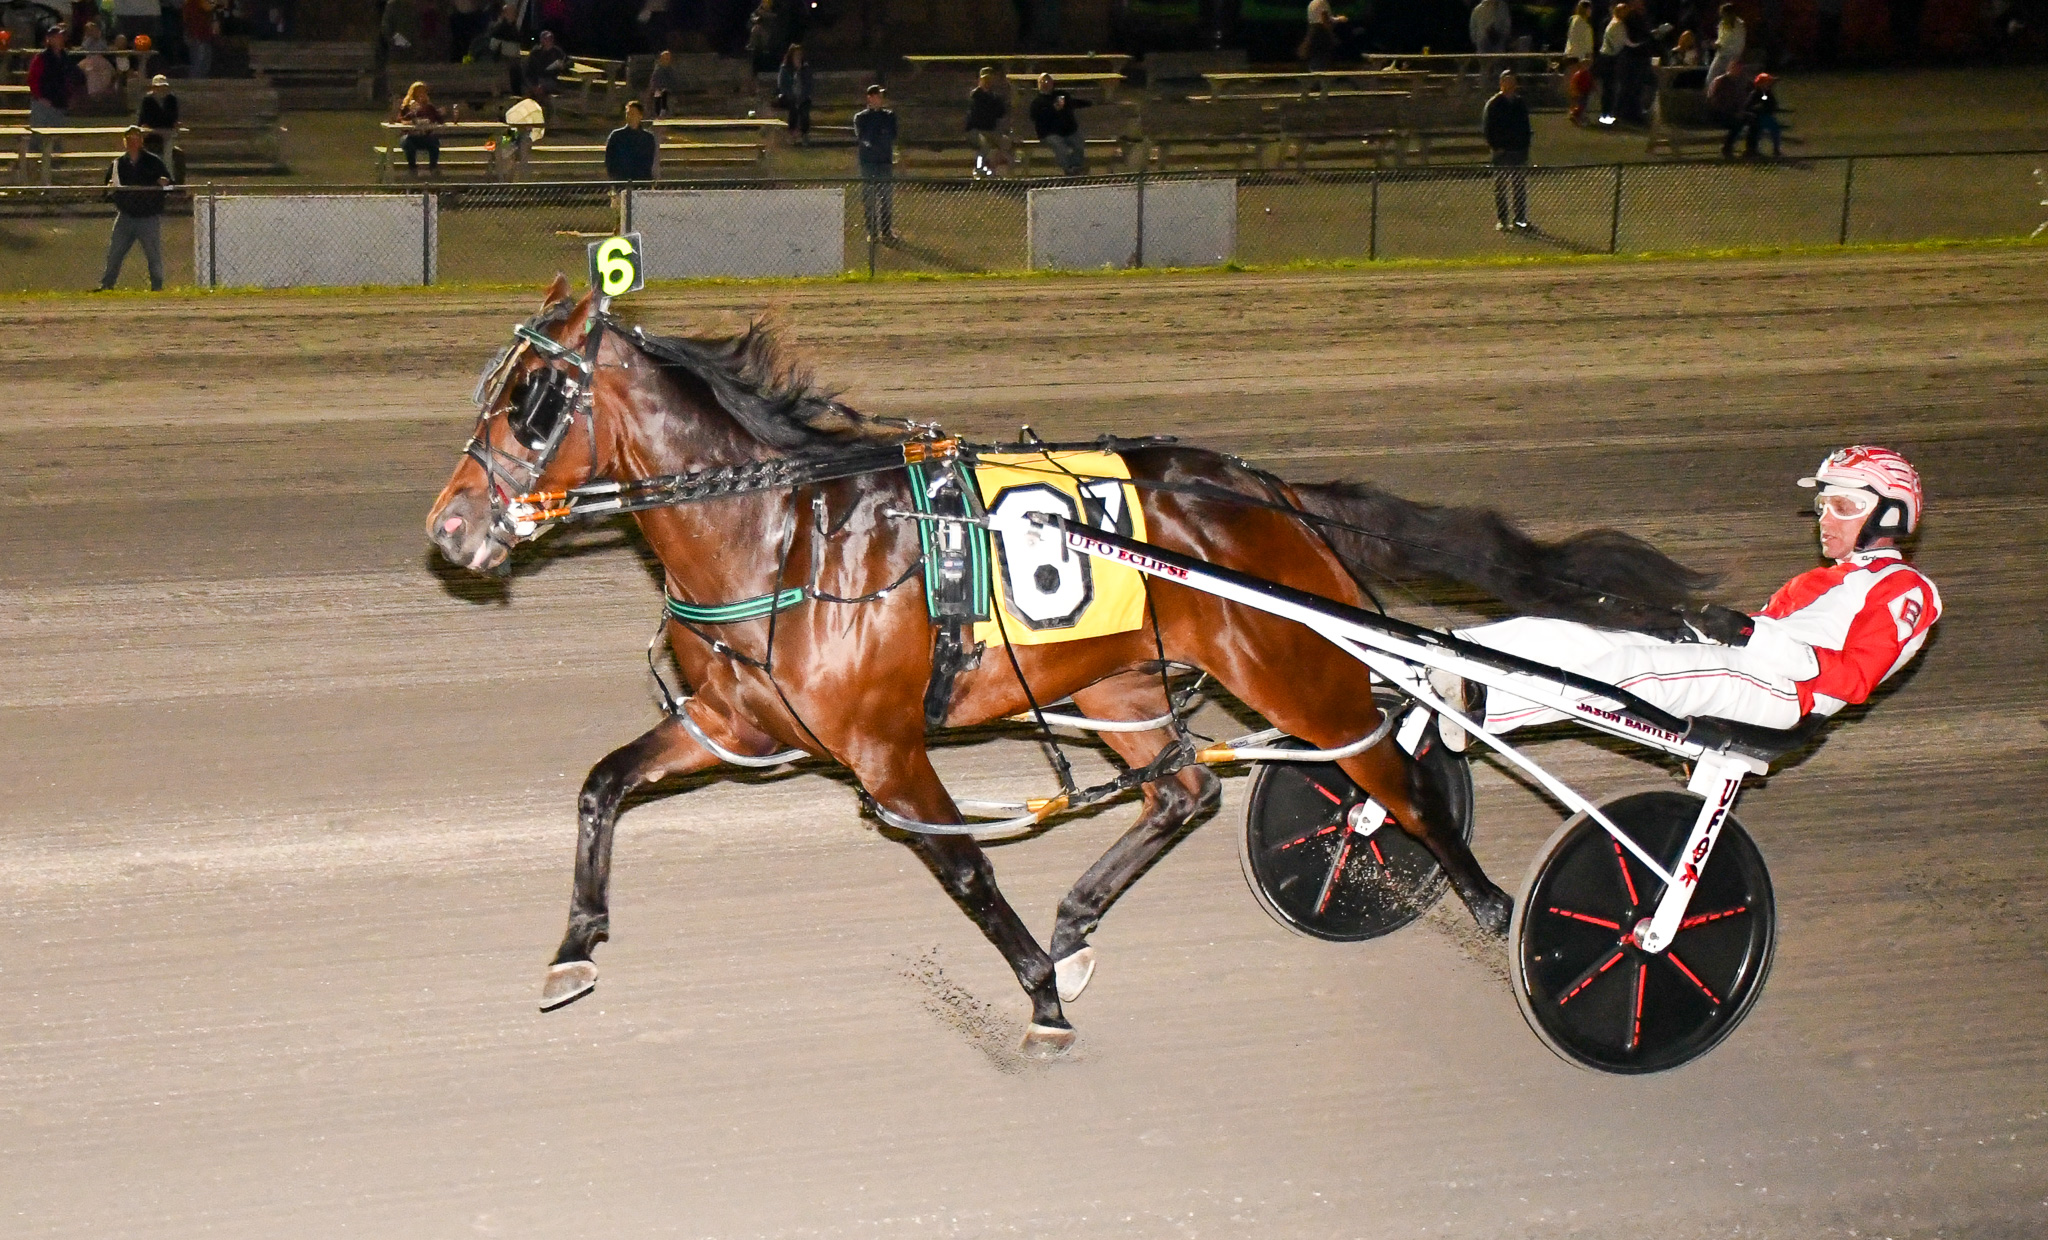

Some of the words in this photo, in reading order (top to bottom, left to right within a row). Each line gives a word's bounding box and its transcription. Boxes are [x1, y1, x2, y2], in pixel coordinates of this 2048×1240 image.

[597, 236, 636, 296] 6
[1078, 480, 1123, 535] 7
[990, 484, 1092, 629] 6
[1068, 532, 1113, 556] UFO
[1117, 547, 1189, 580] ECLIPSE
[1900, 597, 1922, 628] B
[1576, 702, 1621, 723] JASON
[1692, 778, 1739, 864] UFO
